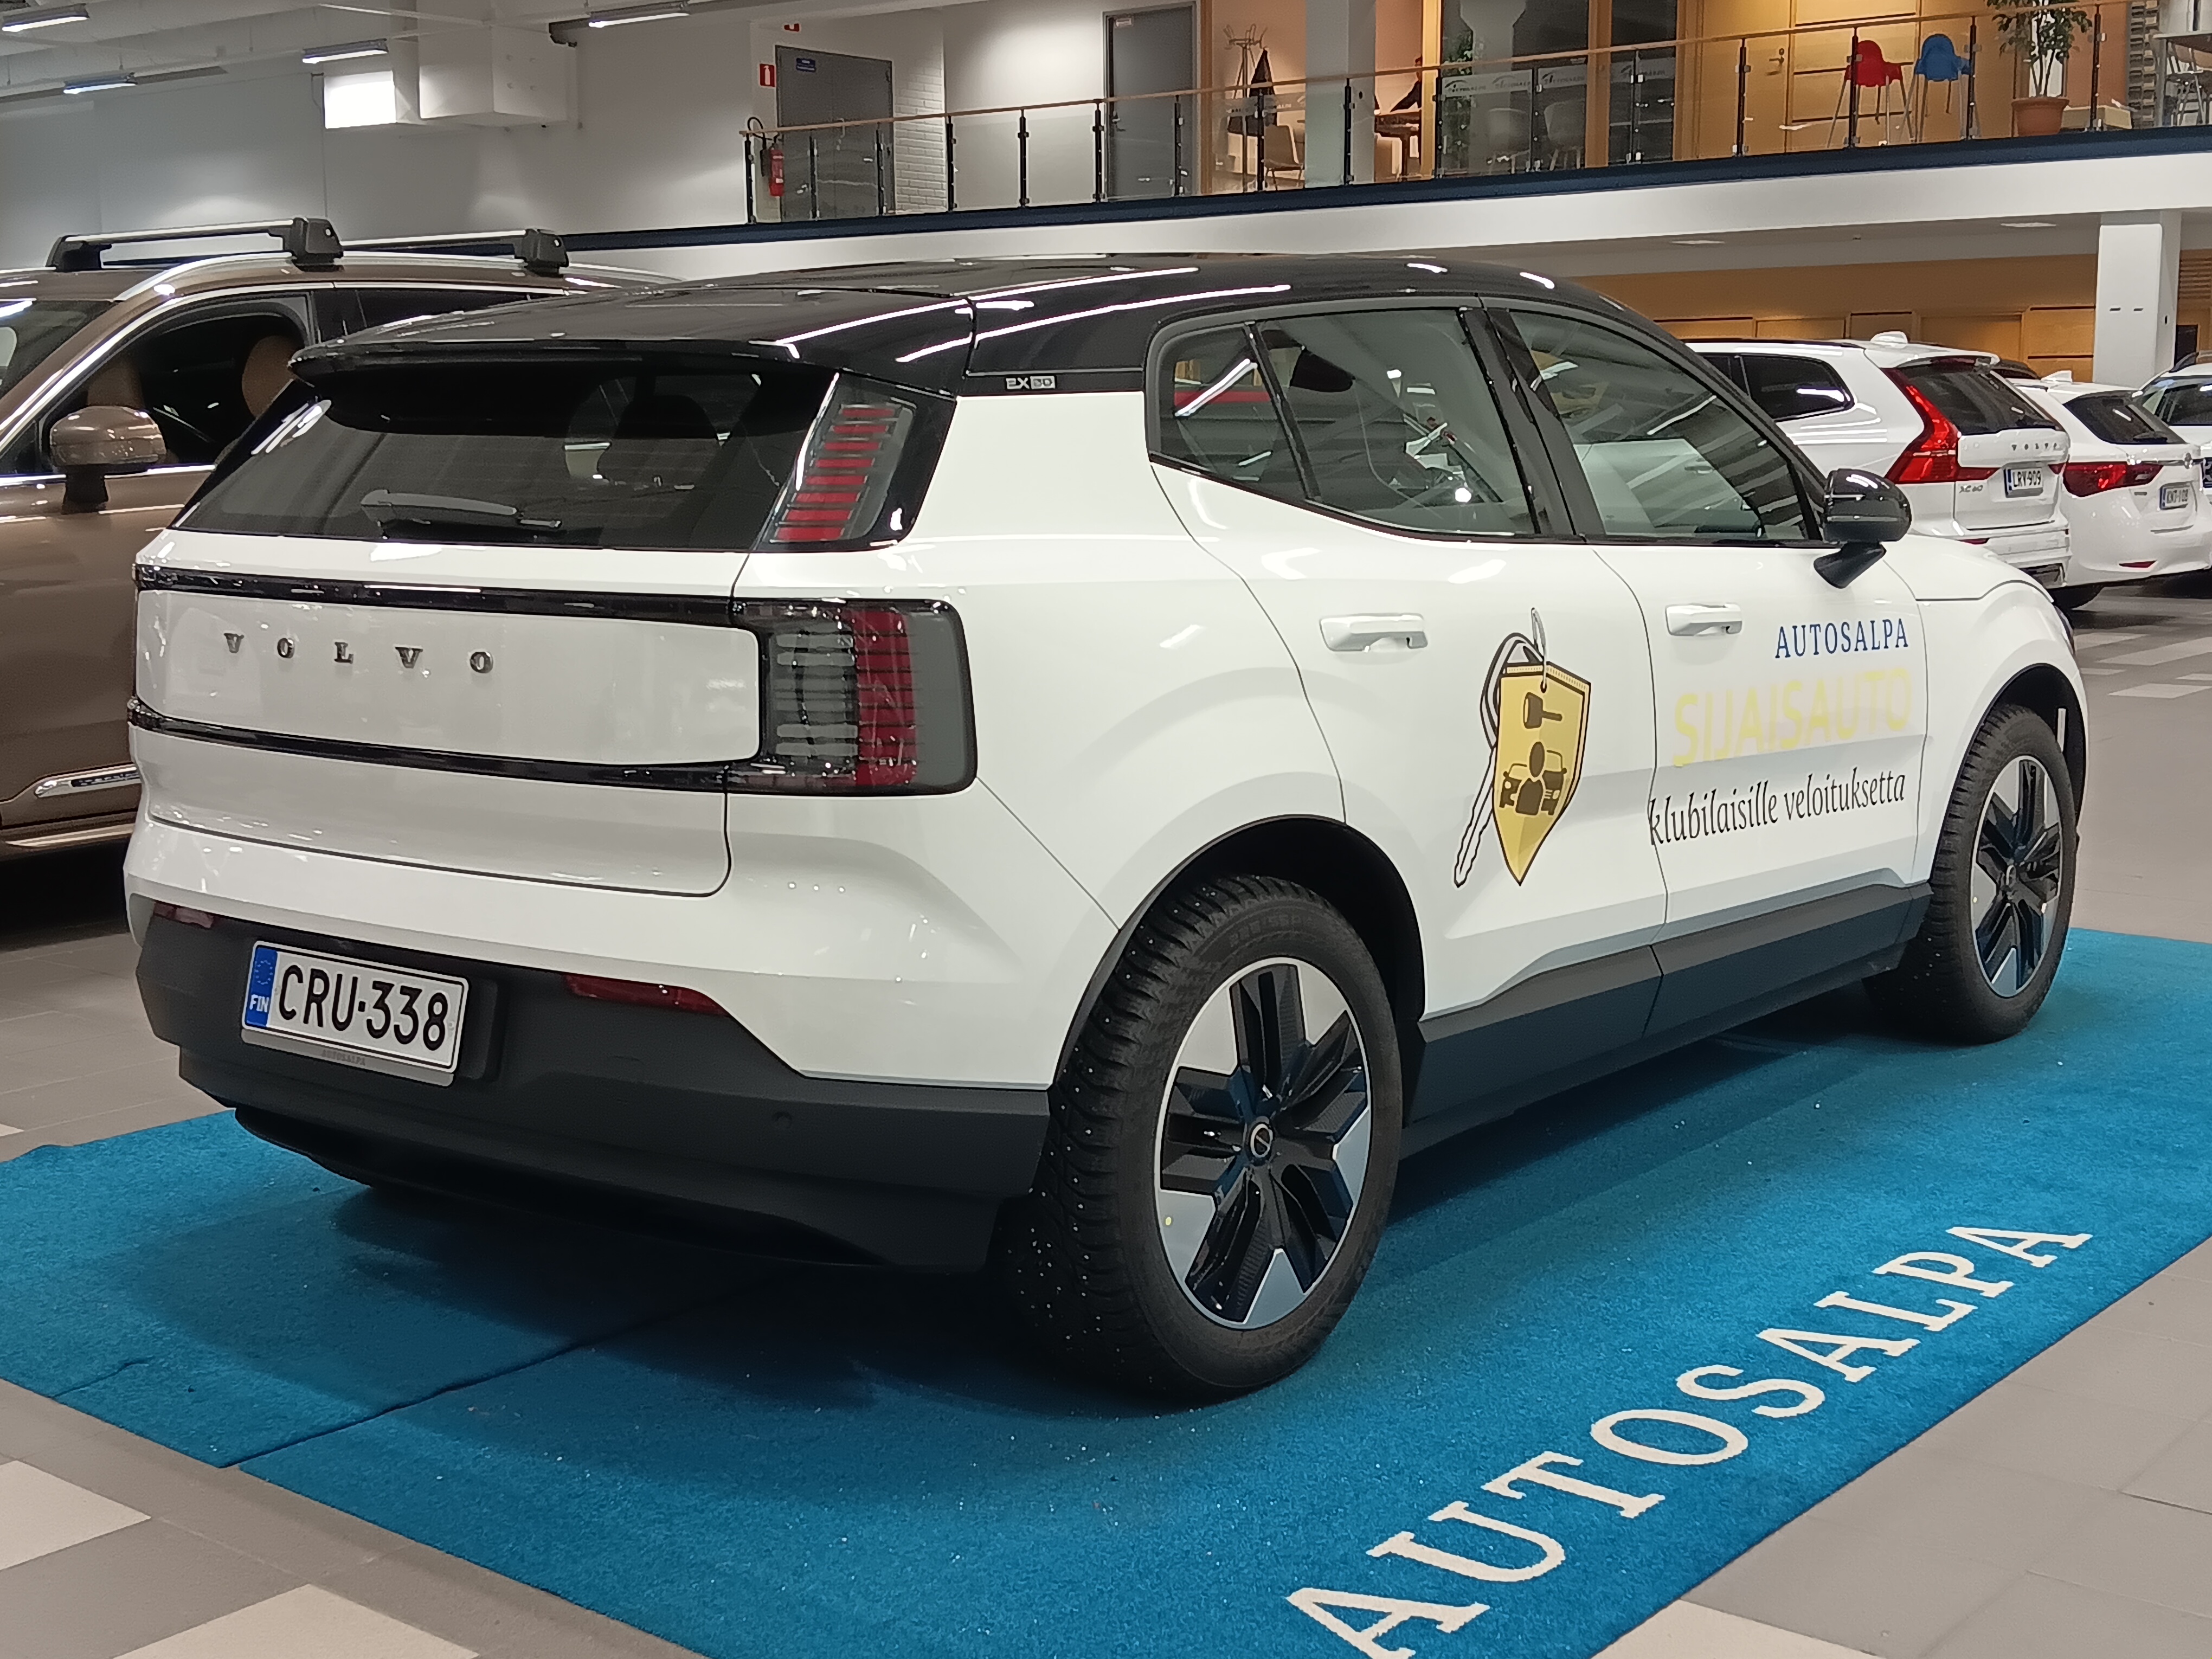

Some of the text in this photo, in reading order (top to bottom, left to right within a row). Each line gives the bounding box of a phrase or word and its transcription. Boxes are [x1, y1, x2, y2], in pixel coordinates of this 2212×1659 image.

[224, 633, 493, 673] VOLVO
[1775, 618, 1908, 659] AUTOSALPA
[1673, 667, 1912, 767] SIJAISAUTO
[1649, 767, 1905, 846] klubilaisille veloituksetta
[249, 964, 448, 1051] FIN CRU-338
[1286, 1226, 2093, 1659] AUTOSALPA
